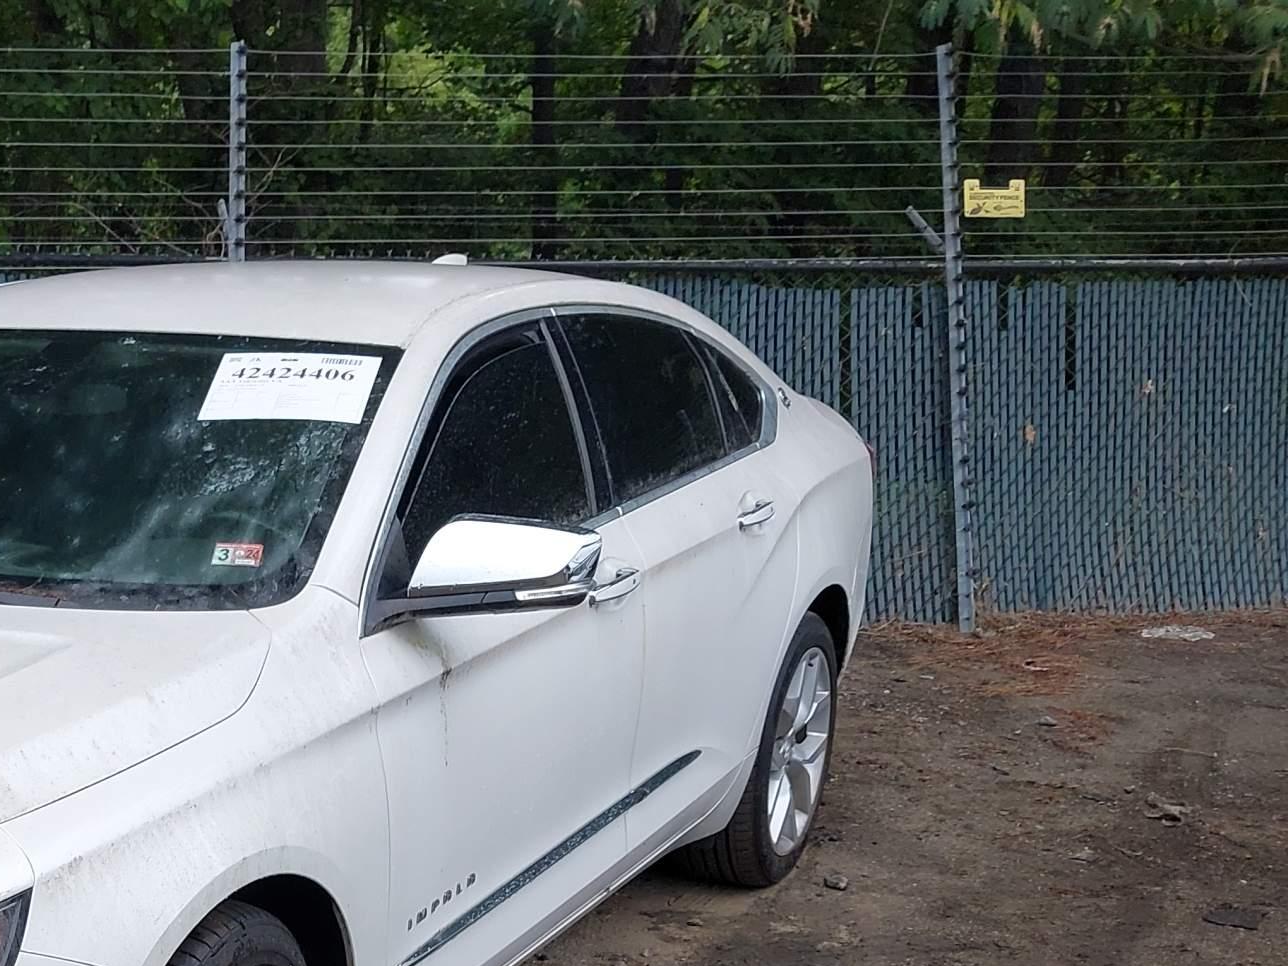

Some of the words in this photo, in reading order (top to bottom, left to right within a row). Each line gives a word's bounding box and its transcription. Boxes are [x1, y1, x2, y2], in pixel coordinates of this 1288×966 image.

[231, 367, 357, 382] 42424406
[217, 548, 230, 561] 3
[407, 872, 477, 932] IMPALA
